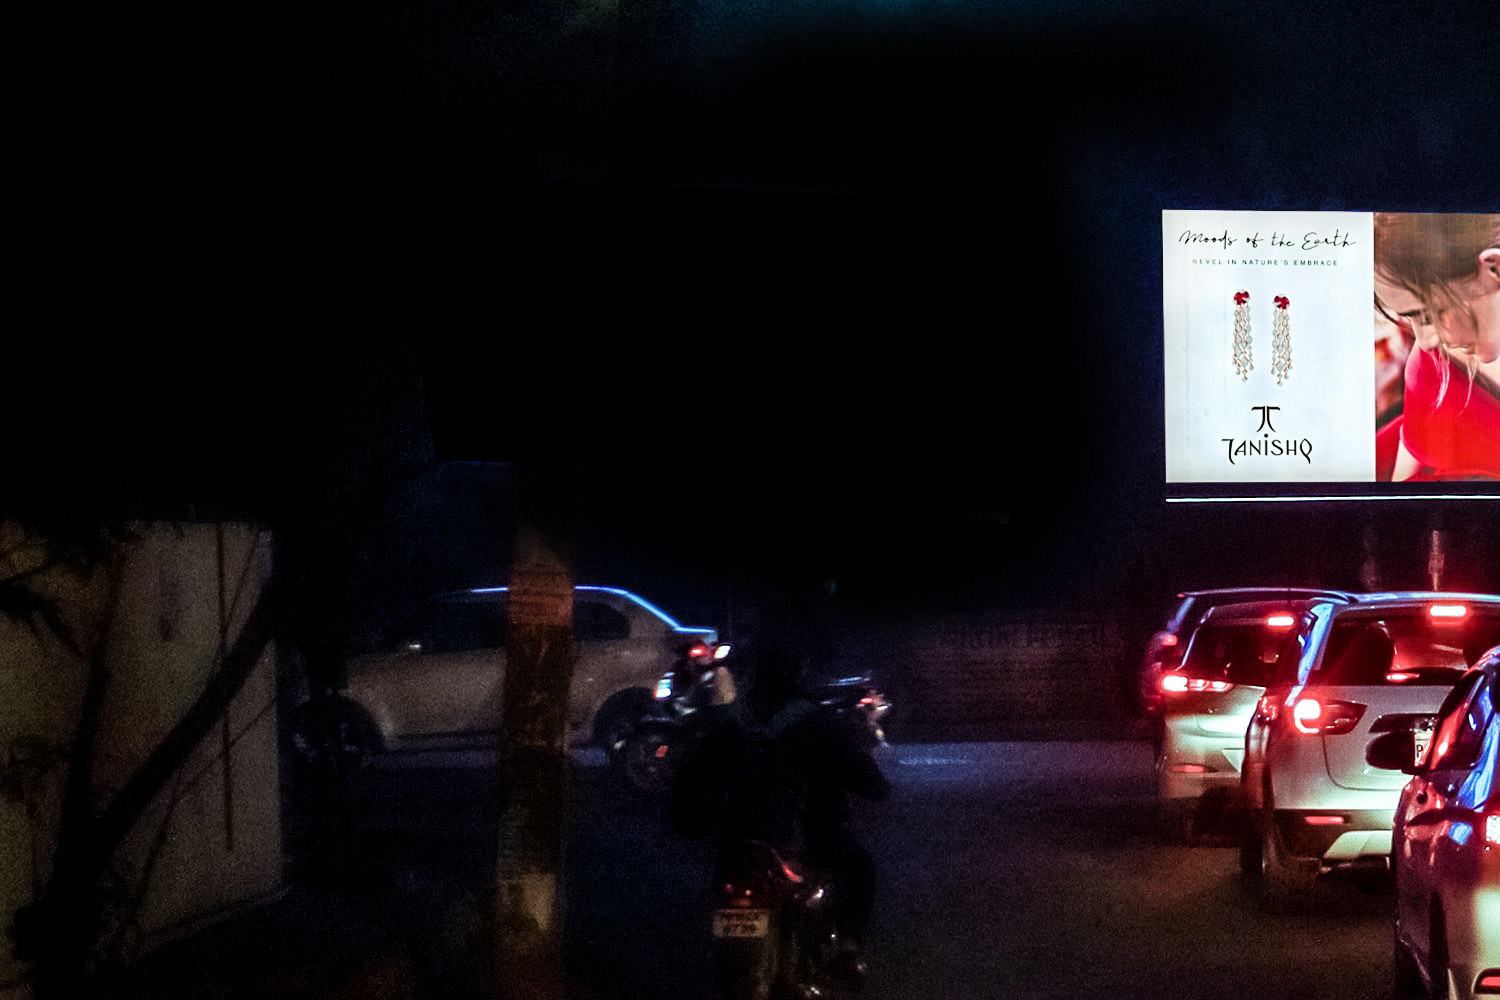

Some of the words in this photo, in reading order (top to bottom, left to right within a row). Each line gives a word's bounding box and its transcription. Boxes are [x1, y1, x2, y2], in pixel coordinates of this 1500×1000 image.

[1178, 229, 1238, 250] Moods
[1245, 231, 1264, 249] of
[1271, 231, 1295, 248] the
[1301, 229, 1356, 251] Earth
[1192, 258, 1222, 266] REVEL
[1227, 258, 1237, 266] IN
[1241, 258, 1289, 267] NATURE'S
[1293, 259, 1338, 267] EMBRACE
